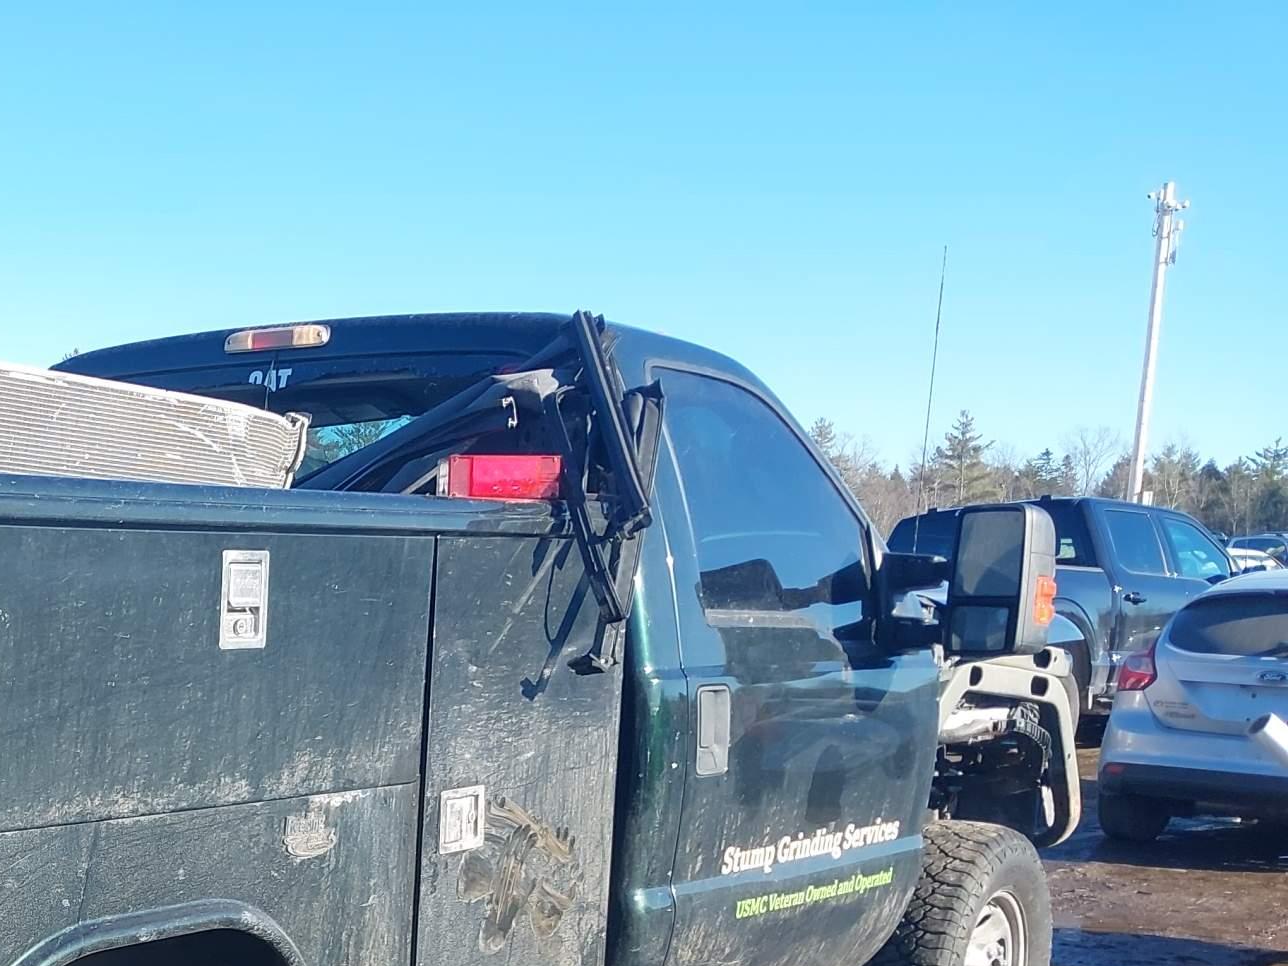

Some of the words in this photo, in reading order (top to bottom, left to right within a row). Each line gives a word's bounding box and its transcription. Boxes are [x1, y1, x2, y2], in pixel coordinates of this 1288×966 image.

[721, 845, 775, 874] Stump
[777, 828, 844, 863] Grinding
[843, 817, 900, 850] Services
[735, 895, 768, 919] USMC
[769, 892, 805, 911] Veteran
[805, 880, 838, 903] Owned
[837, 875, 855, 895] and
[854, 866, 893, 894] Operated
